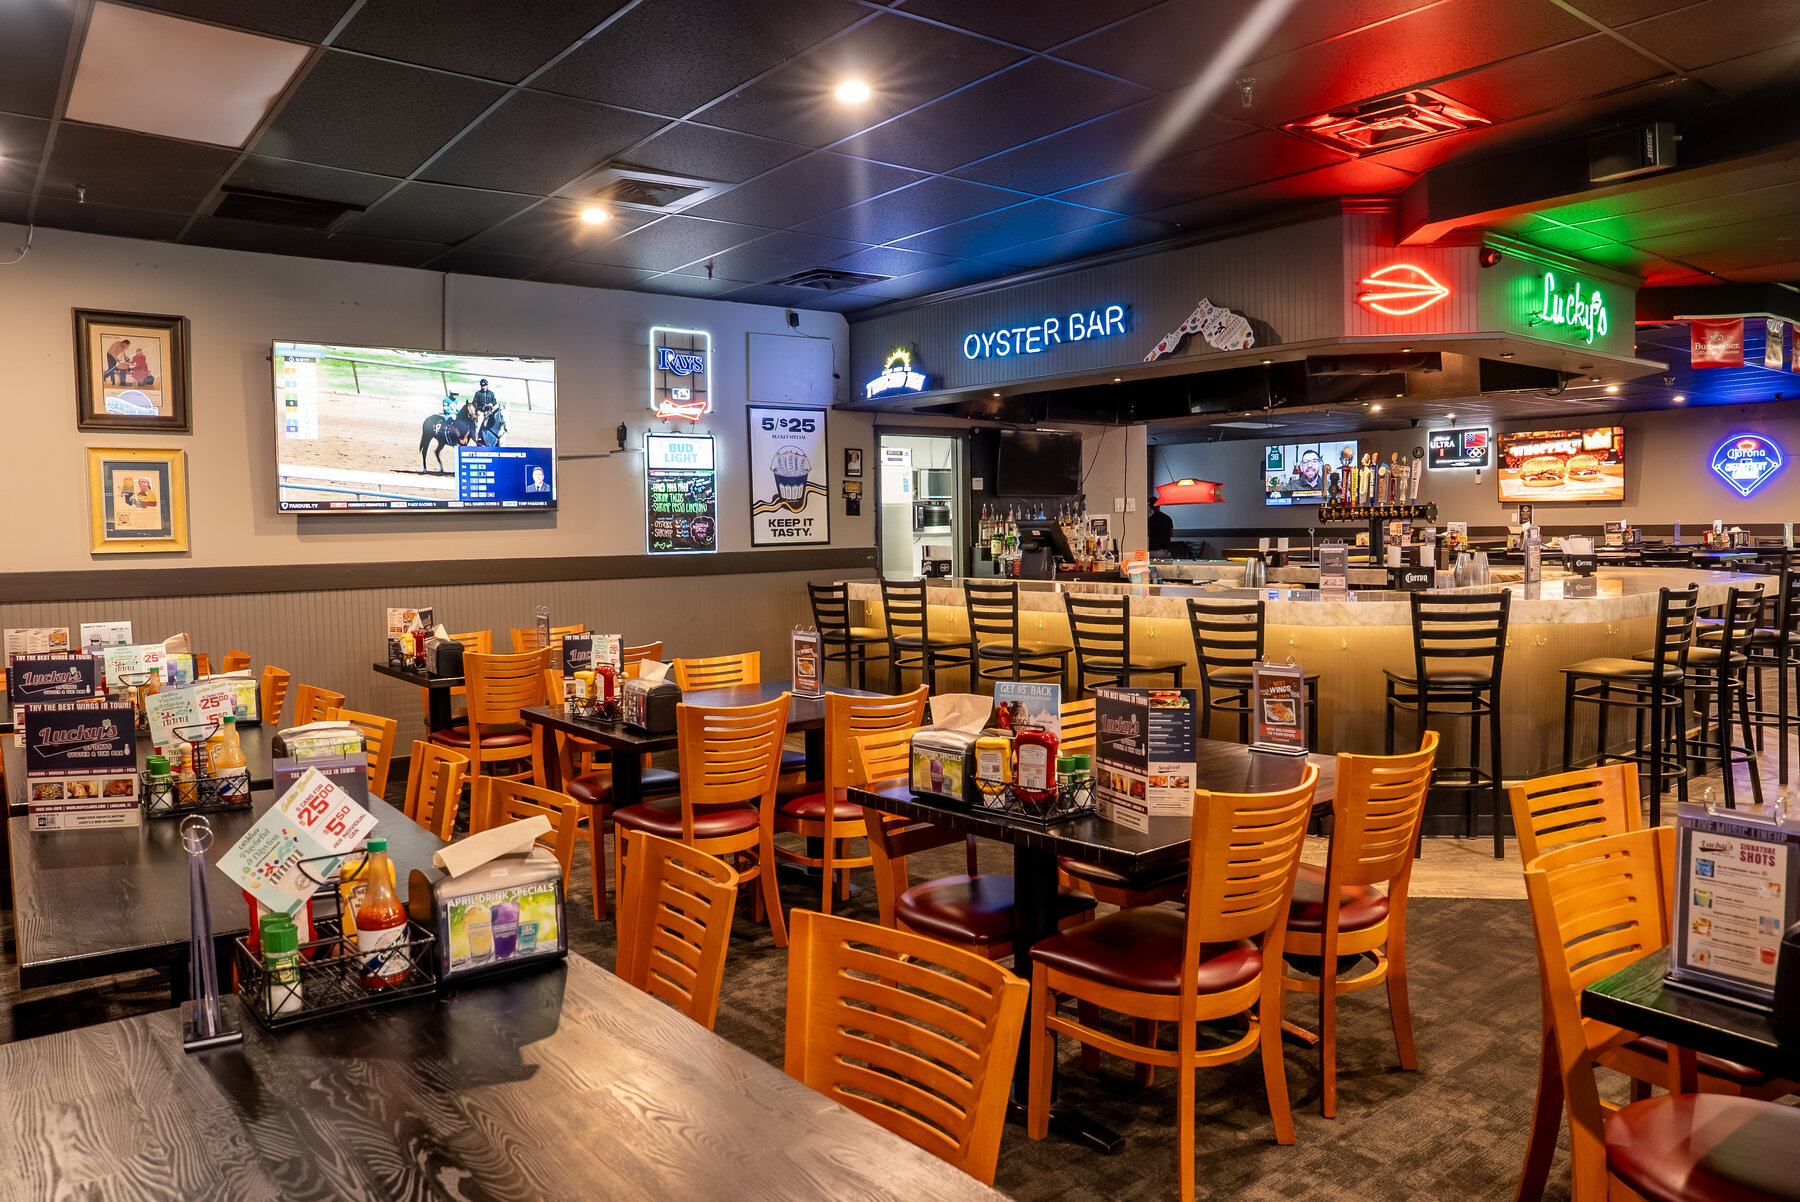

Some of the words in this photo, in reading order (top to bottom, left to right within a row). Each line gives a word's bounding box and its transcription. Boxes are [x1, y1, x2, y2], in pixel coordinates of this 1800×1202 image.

[1538, 272, 1608, 344] Lucky's
[964, 318, 1061, 360] OYSTER
[1069, 305, 1125, 341] BAR
[669, 444, 694, 453] BUD
[1430, 440, 1456, 449] ULTRA
[664, 454, 698, 463] LIGHT
[1727, 448, 1766, 460] Corona
[768, 518, 800, 528] KEEP
[804, 518, 814, 526] IT
[770, 528, 812, 537] TASTY.
[1405, 573, 1428, 583] Cuervo
[22, 670, 82, 685] Lucky's
[1000, 684, 1015, 693] GET
[1030, 686, 1052, 696] BACK
[1100, 713, 1140, 735] Lucky's
[39, 725, 118, 745] Lucky's
[940, 752, 962, 761] SPECIALS
[300, 795, 313, 808] CANS
[313, 784, 323, 796] FOR
[333, 839, 342, 848] PER
[343, 813, 366, 838] INDIVIDUAL
[348, 829, 359, 840] CAN
[1716, 822, 1748, 836] MUSIC
[1751, 827, 1787, 843] LINEUP
[1700, 840, 1733, 850] Lucky's
[1740, 843, 1776, 855] SIGNATURE
[1740, 851, 1776, 867] SHOTS
[448, 897, 475, 907] APRIL
[480, 891, 508, 903] DRINK
[512, 883, 554, 898] SPECIALS
